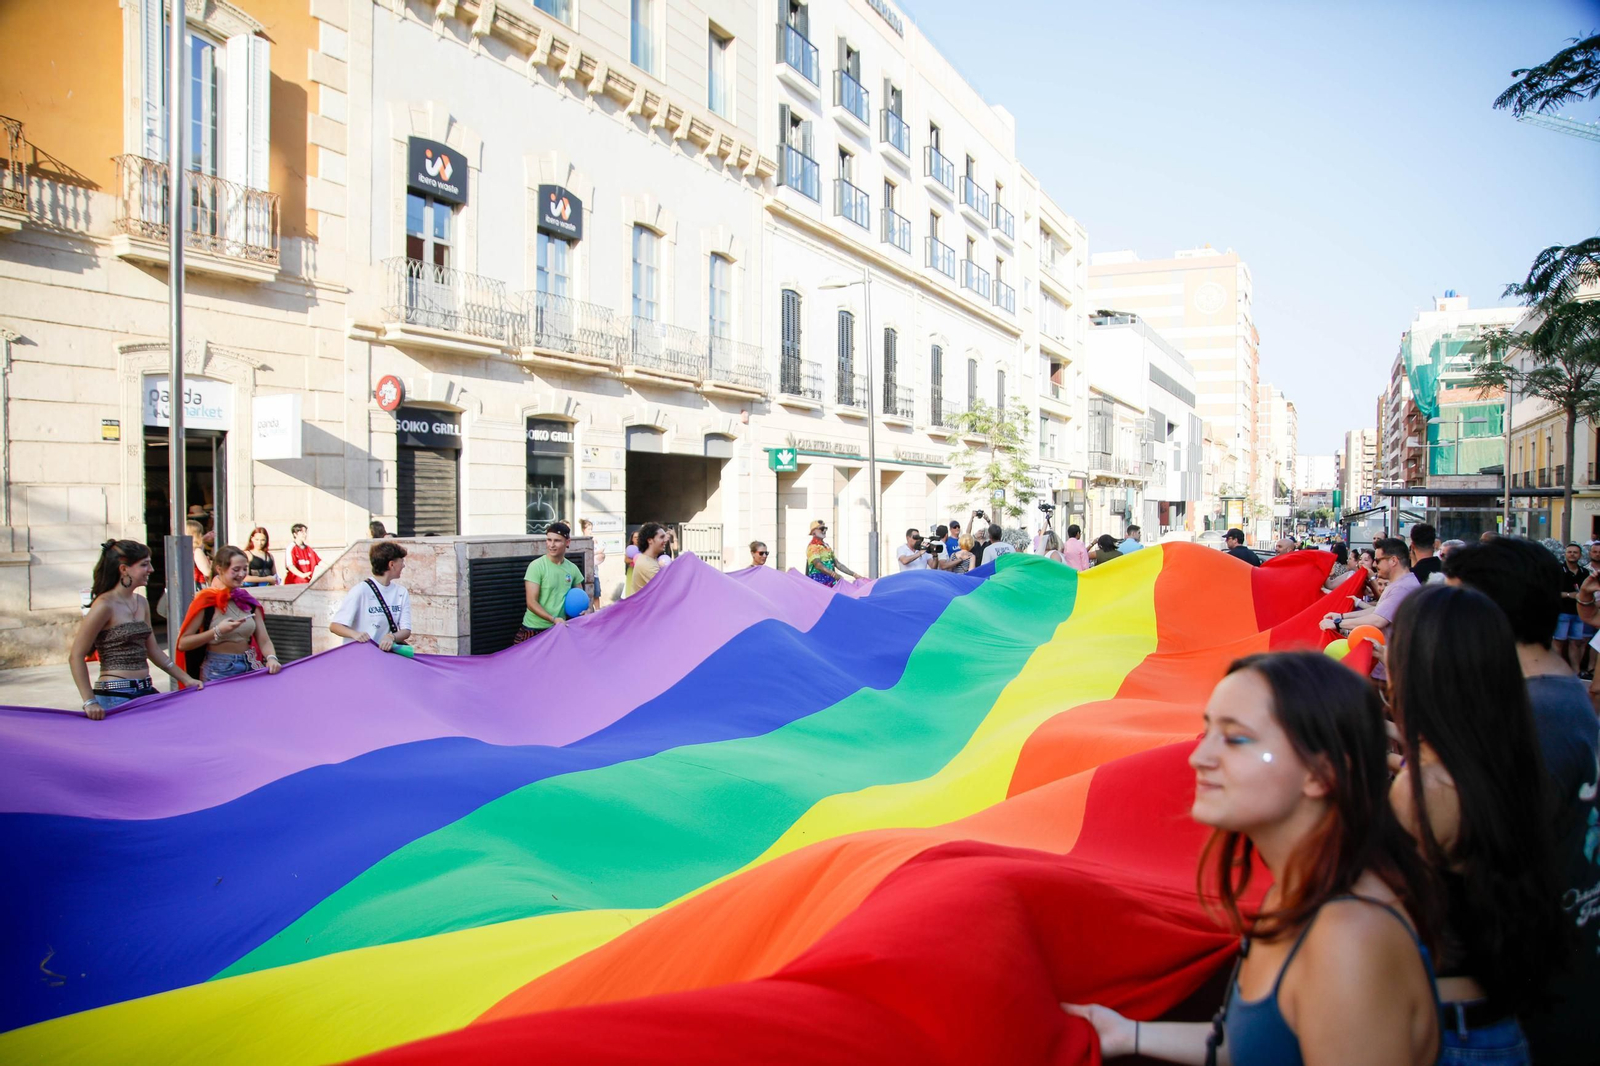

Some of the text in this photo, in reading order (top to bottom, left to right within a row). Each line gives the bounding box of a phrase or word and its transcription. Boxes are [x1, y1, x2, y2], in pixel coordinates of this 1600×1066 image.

[418, 172, 459, 195] ibero waste
[545, 213, 577, 232] ibero waste
[148, 388, 202, 406] pada
[258, 418, 279, 430] panda
[432, 422, 462, 436] GRILL
[551, 431, 575, 443] GRILL
